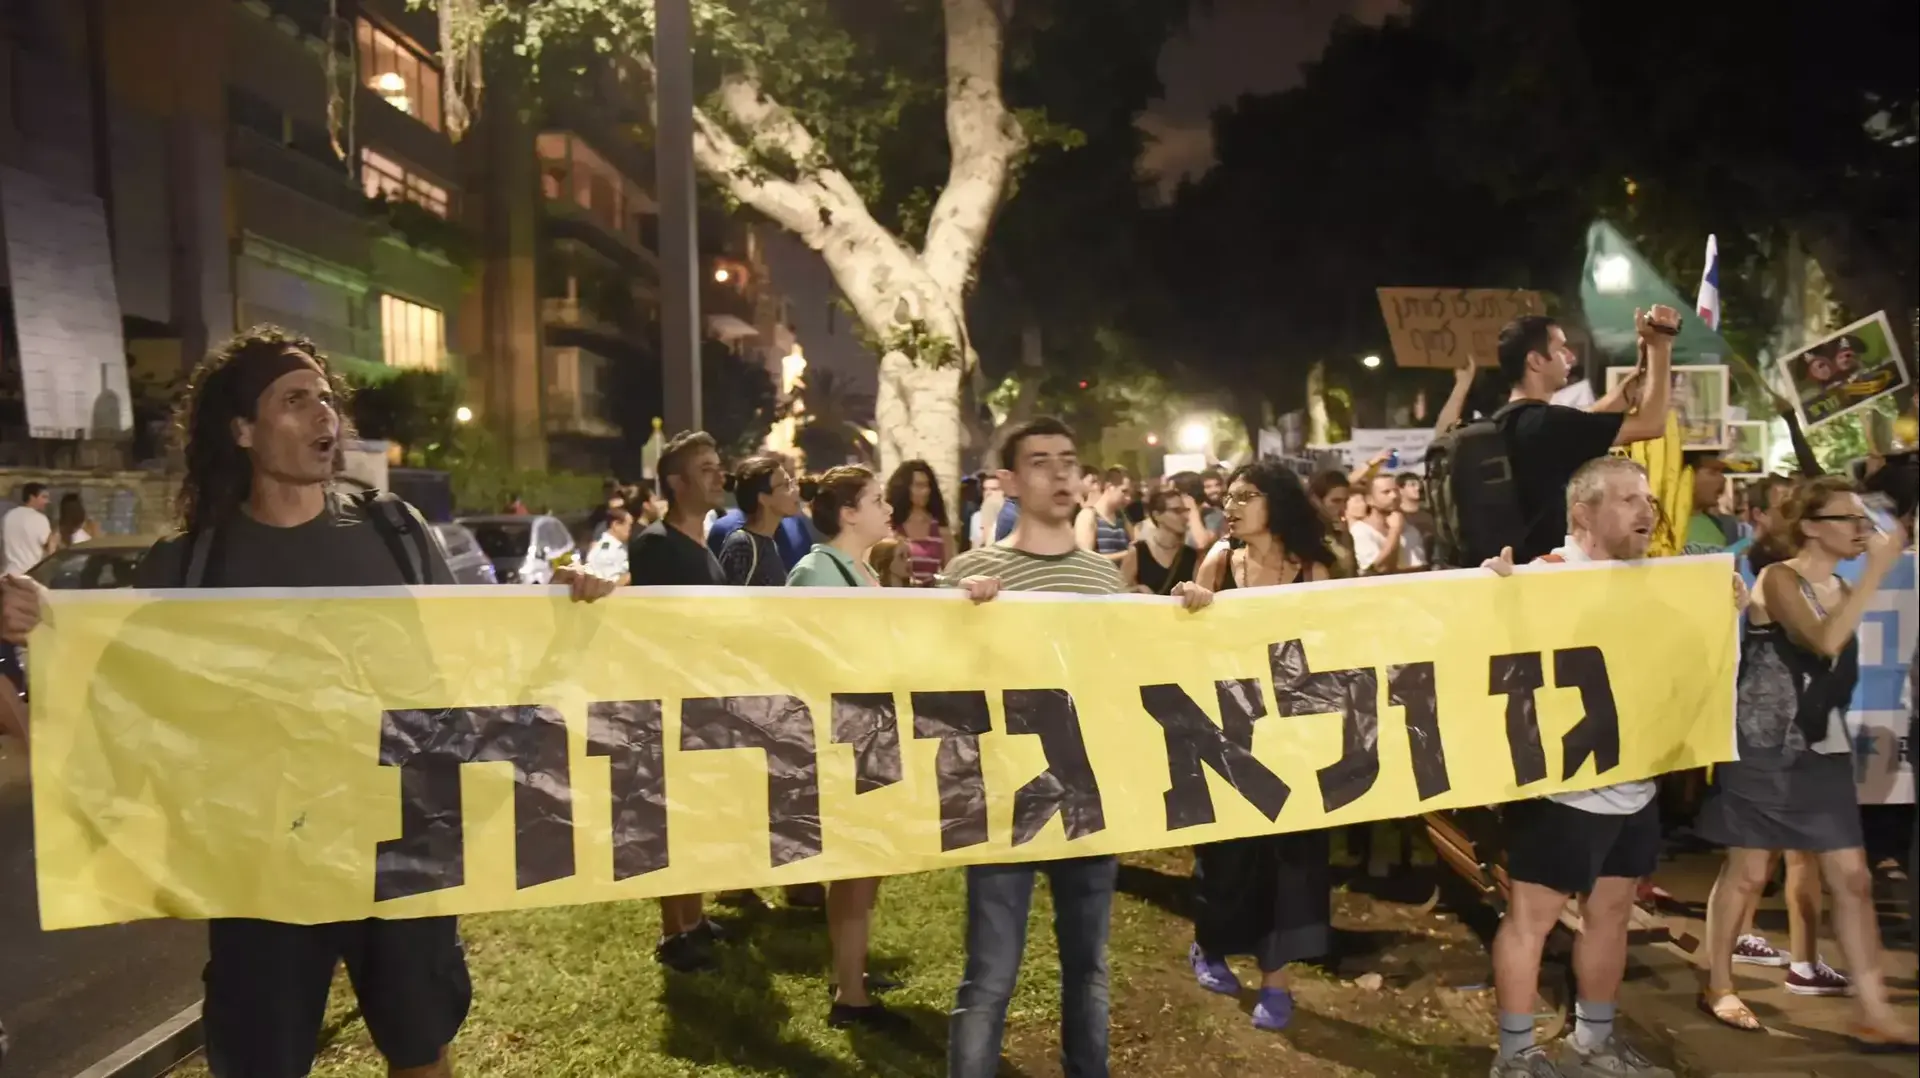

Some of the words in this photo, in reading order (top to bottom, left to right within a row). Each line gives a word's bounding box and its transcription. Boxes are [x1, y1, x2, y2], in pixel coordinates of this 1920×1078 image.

[374, 688, 1106, 903] גזירות
[1140, 638, 1451, 831] ולא
[1488, 646, 1620, 787] גז
